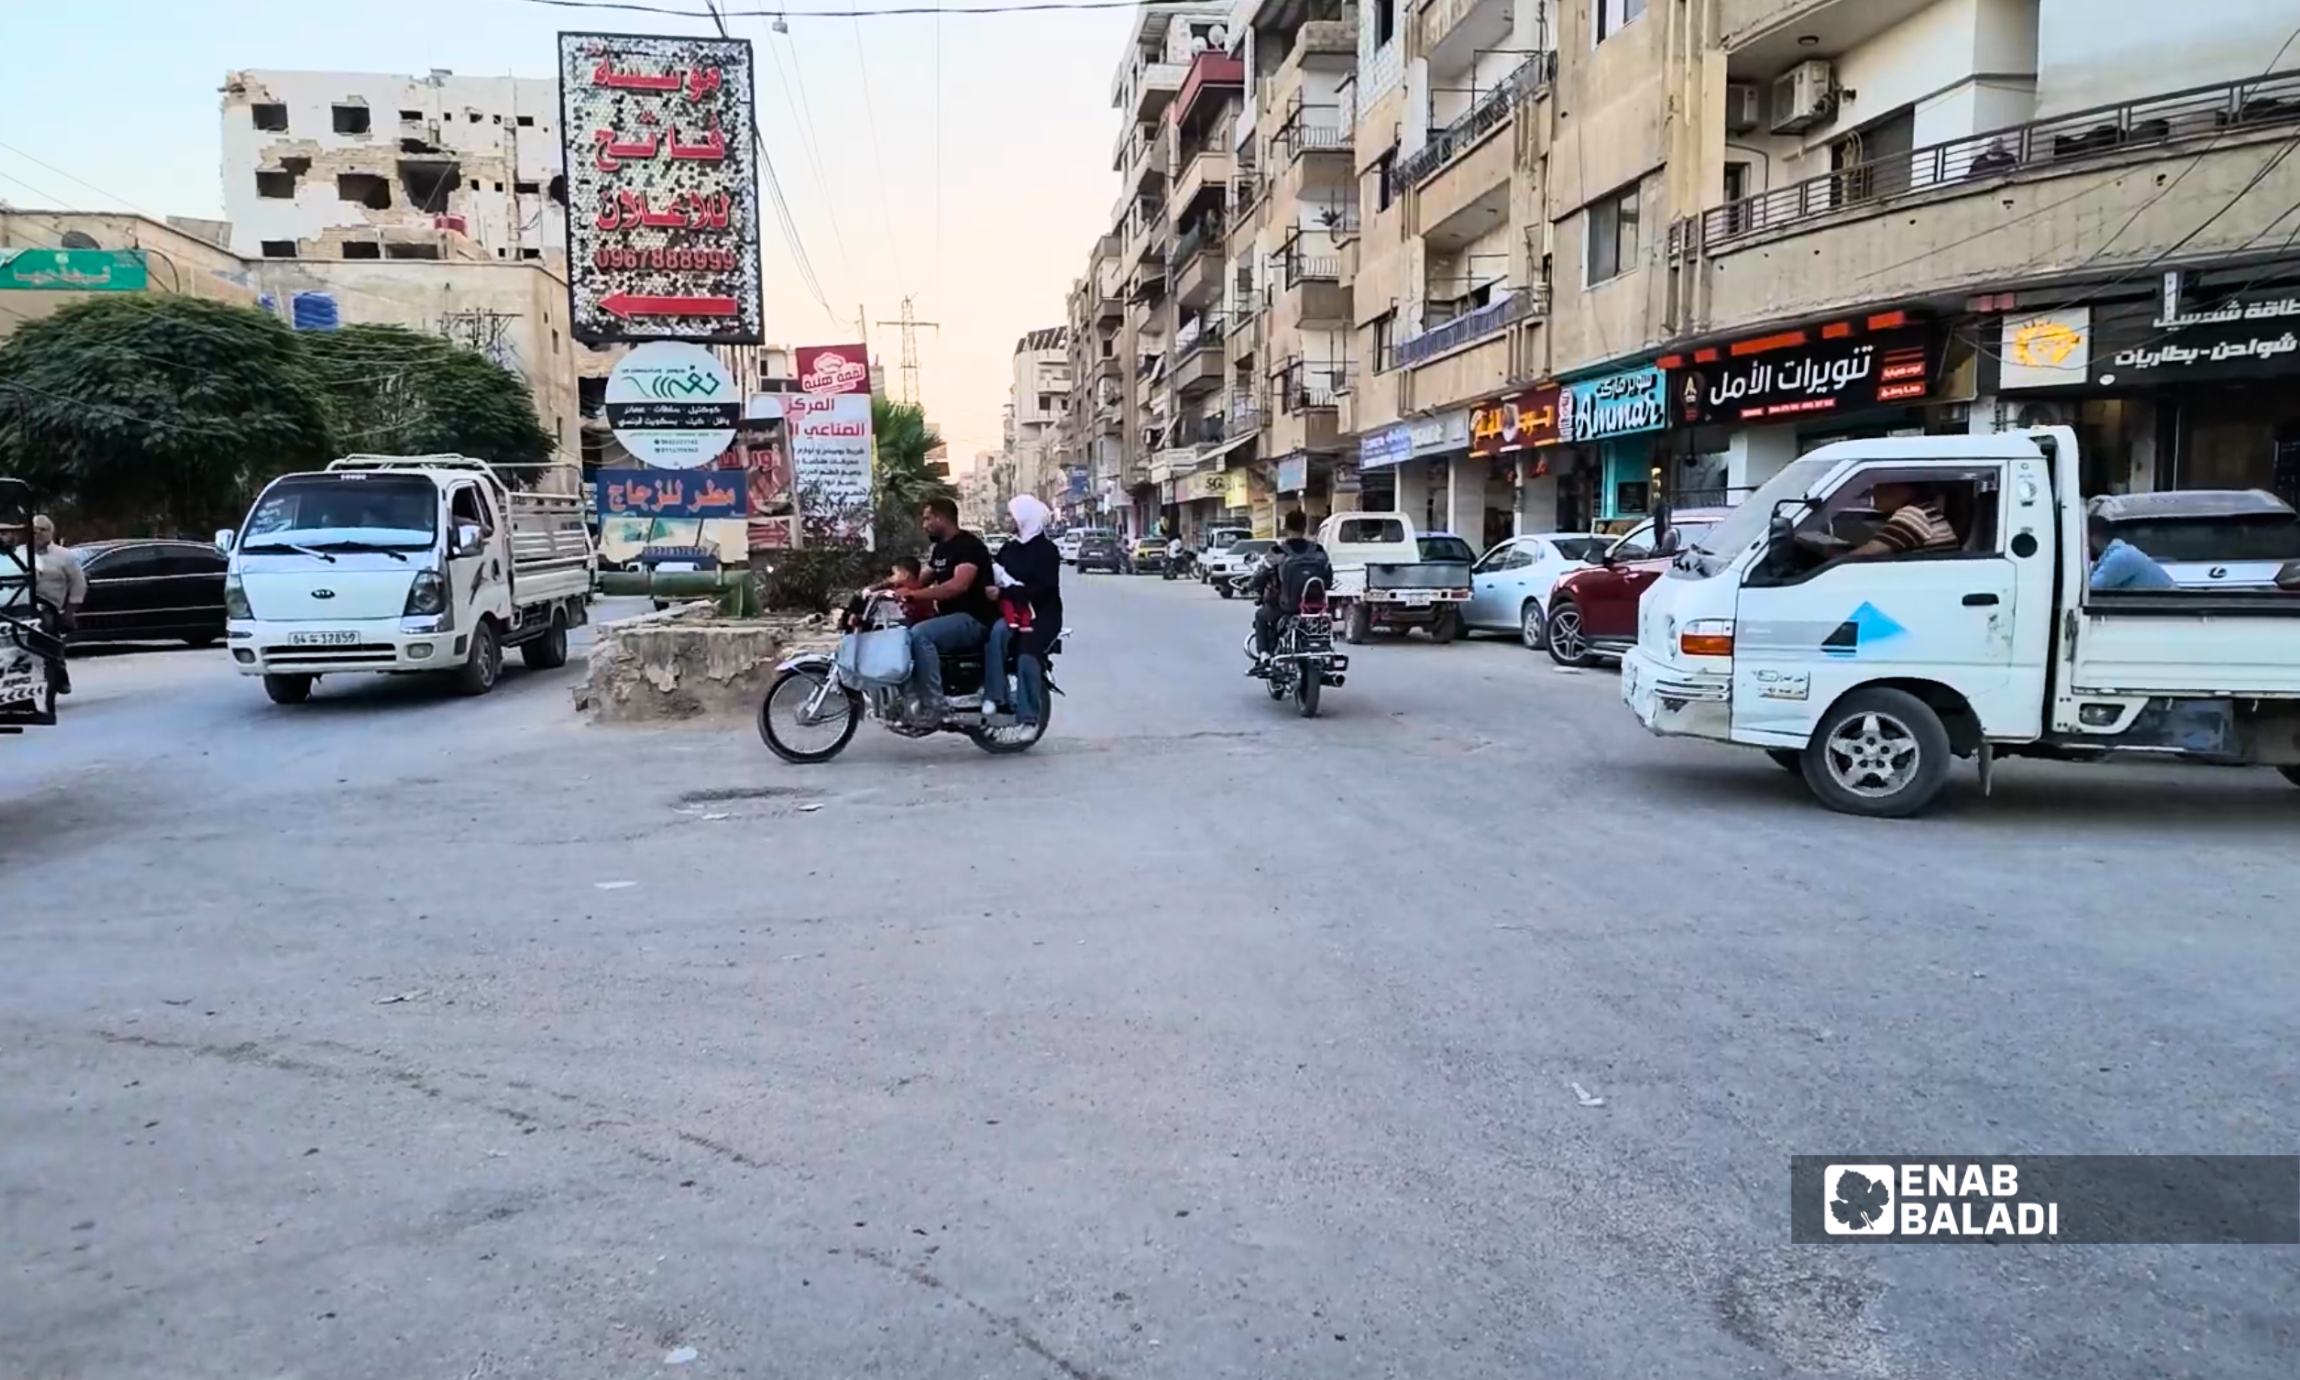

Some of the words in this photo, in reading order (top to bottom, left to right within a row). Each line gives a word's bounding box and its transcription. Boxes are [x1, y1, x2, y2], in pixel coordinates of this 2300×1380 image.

[1710, 359, 1772, 405] الأمل
[1777, 344, 1874, 394] تنويرات
[786, 398, 835, 414] المركز
[1575, 391, 1661, 439] Ammar
[804, 423, 865, 439] الصناعي
[607, 479, 683, 512] للزجاج
[687, 479, 736, 512] مطر
